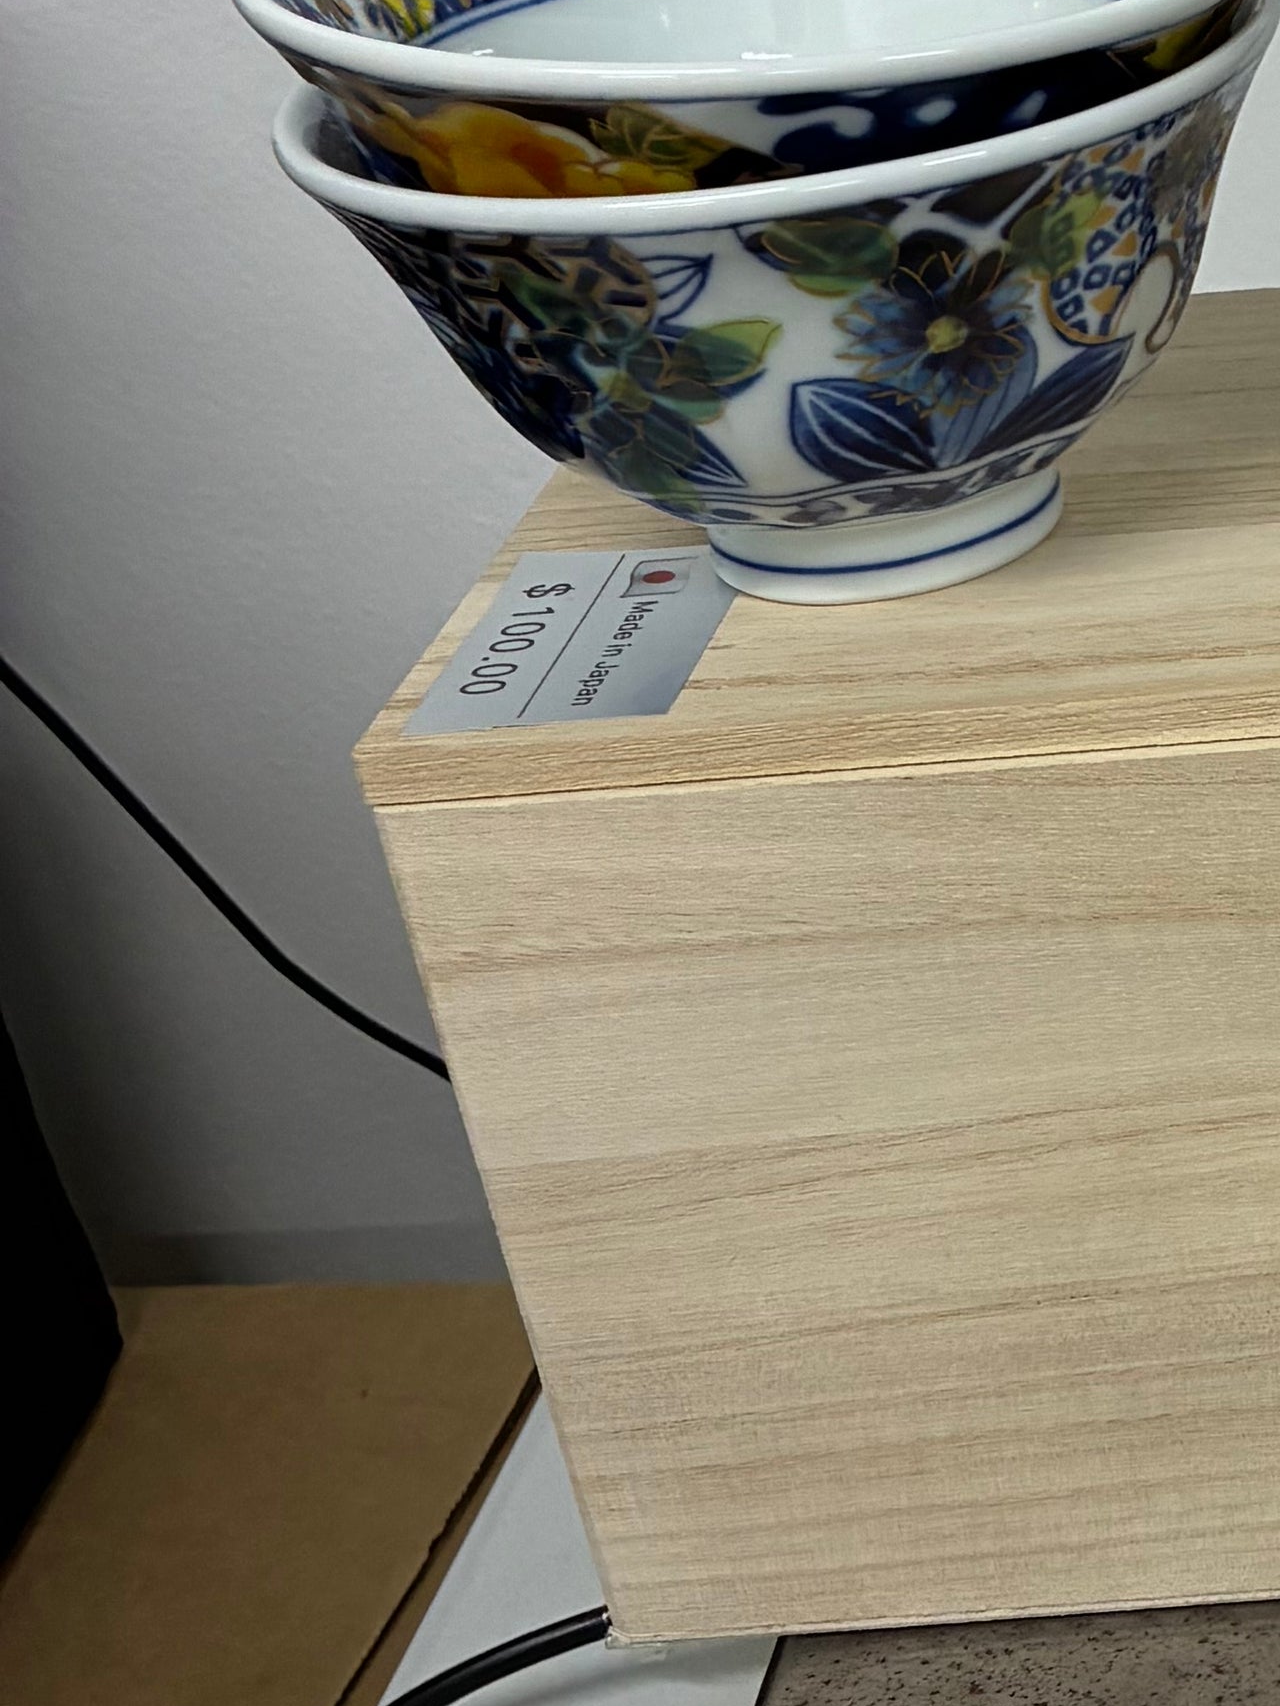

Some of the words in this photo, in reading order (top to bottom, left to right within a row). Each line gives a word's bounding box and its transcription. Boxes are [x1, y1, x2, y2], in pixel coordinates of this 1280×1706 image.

[612, 599, 660, 641] Made
[600, 642, 634, 659] in
[569, 660, 621, 708] Japan
